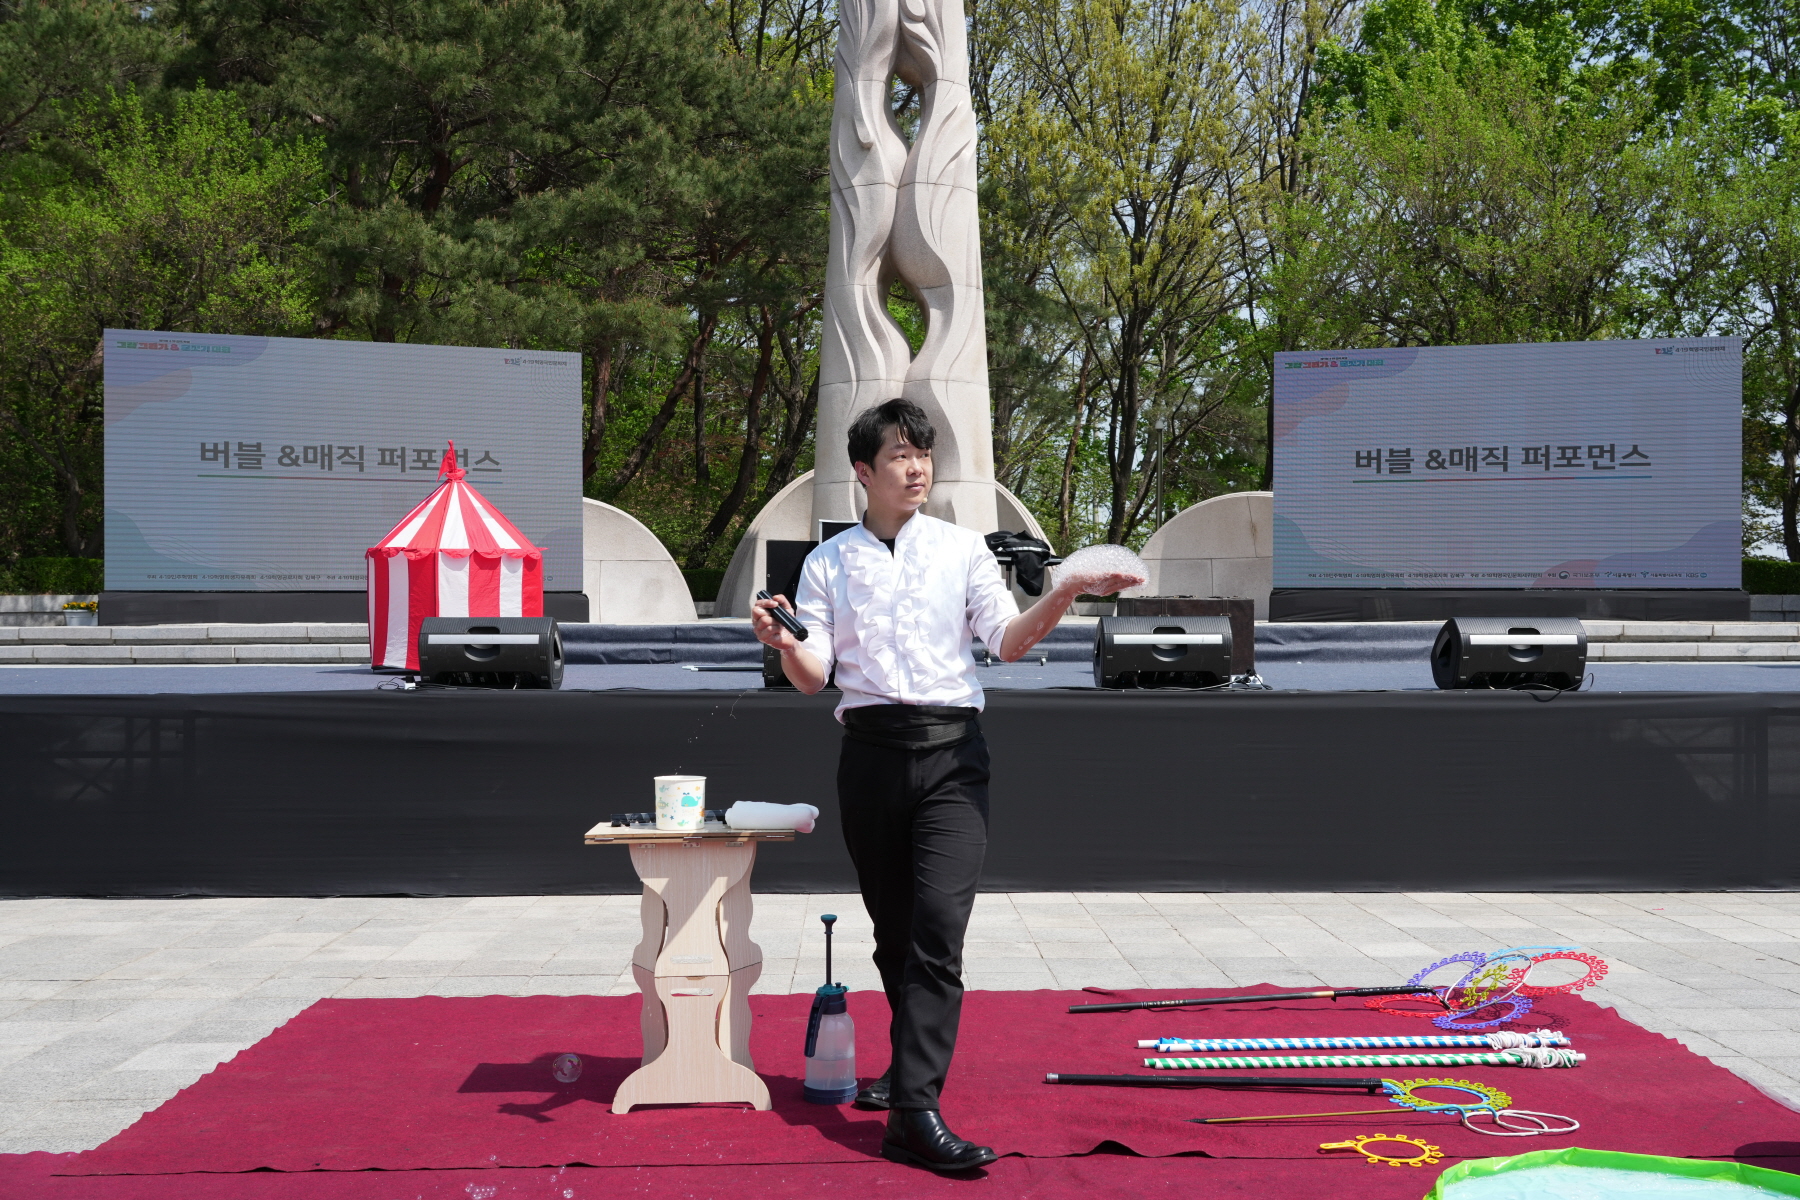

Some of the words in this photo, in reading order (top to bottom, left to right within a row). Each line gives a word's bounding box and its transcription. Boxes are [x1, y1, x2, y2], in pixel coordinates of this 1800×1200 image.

[200, 441, 266, 470] 버블
[1355, 447, 1415, 474] 버블
[1521, 443, 1652, 472] 퍼포먼스
